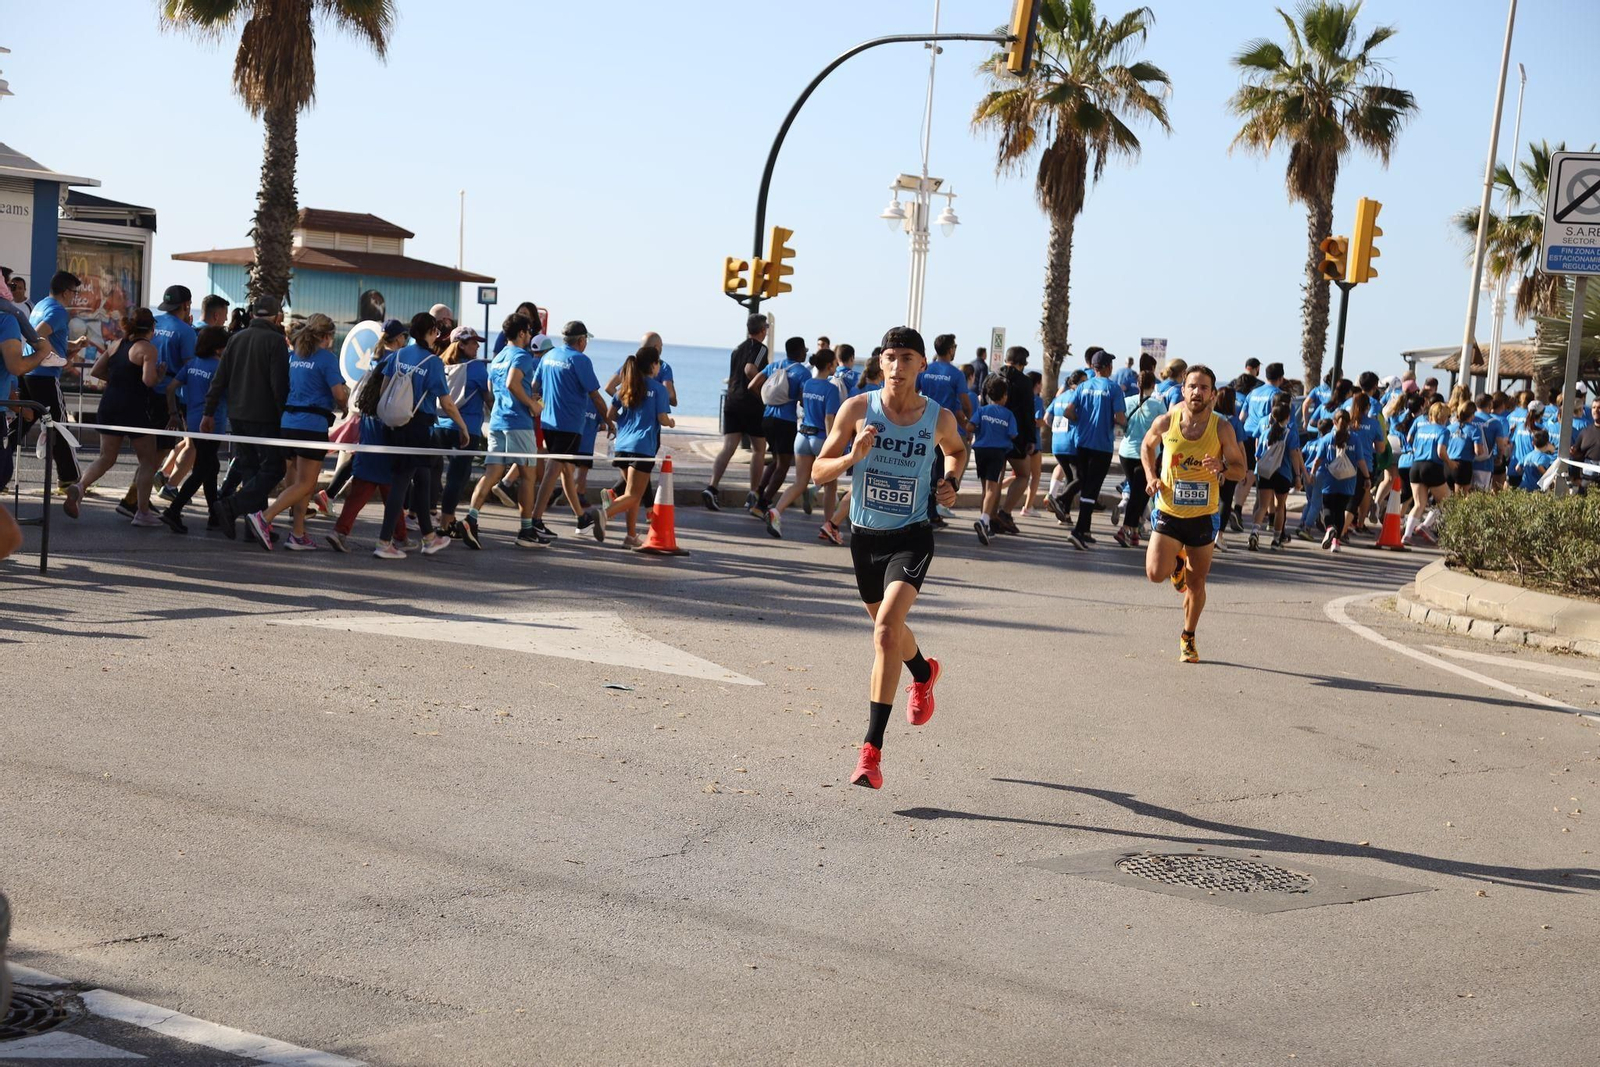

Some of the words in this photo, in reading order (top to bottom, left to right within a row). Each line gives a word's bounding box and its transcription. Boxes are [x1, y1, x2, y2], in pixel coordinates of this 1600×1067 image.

[923, 373, 951, 382] mayoral
[981, 414, 1009, 427] mayoral
[873, 454, 916, 468] ATLETISMO
[870, 487, 909, 503] 1696
[1177, 490, 1205, 499] 1596
